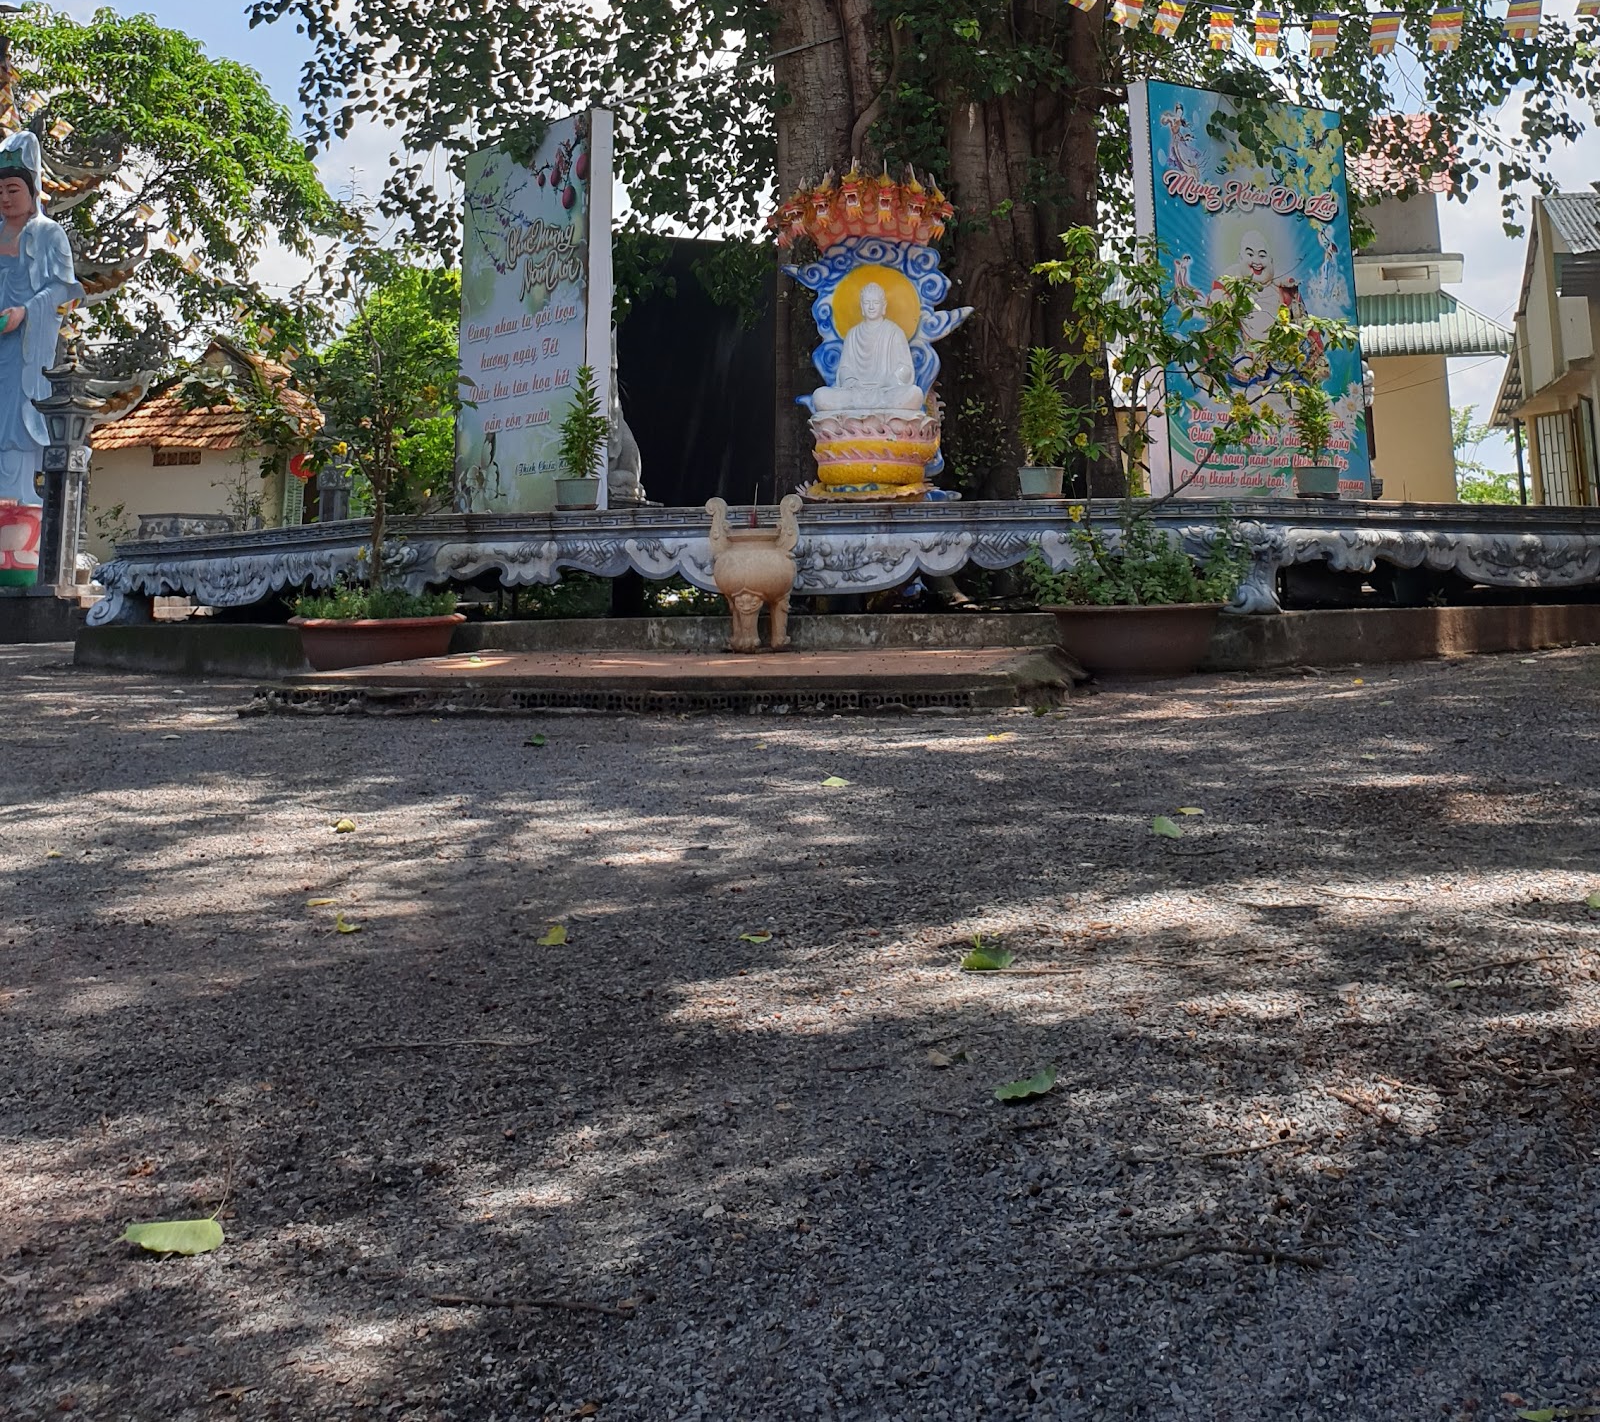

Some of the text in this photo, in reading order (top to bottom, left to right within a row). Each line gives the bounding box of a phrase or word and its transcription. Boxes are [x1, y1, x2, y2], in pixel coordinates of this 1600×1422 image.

[1224, 180, 1270, 211] Xuân
[494, 317, 518, 334] nhau
[521, 314, 531, 328] ta
[555, 304, 575, 322] trọn
[513, 345, 537, 363] ngày
[541, 337, 559, 355] Tết
[493, 380, 509, 398] thu
[512, 379, 529, 394] tàn
[532, 373, 550, 390] hoa
[554, 368, 570, 386] hết
[505, 412, 522, 428] còn
[525, 407, 550, 424] xuân
[1189, 427, 1214, 443] Chúc
[1223, 454, 1244, 466] sang
[1250, 454, 1269, 465] năm
[1273, 454, 1290, 466] mới
[1210, 470, 1235, 485] thành
[1240, 472, 1263, 486] danh
